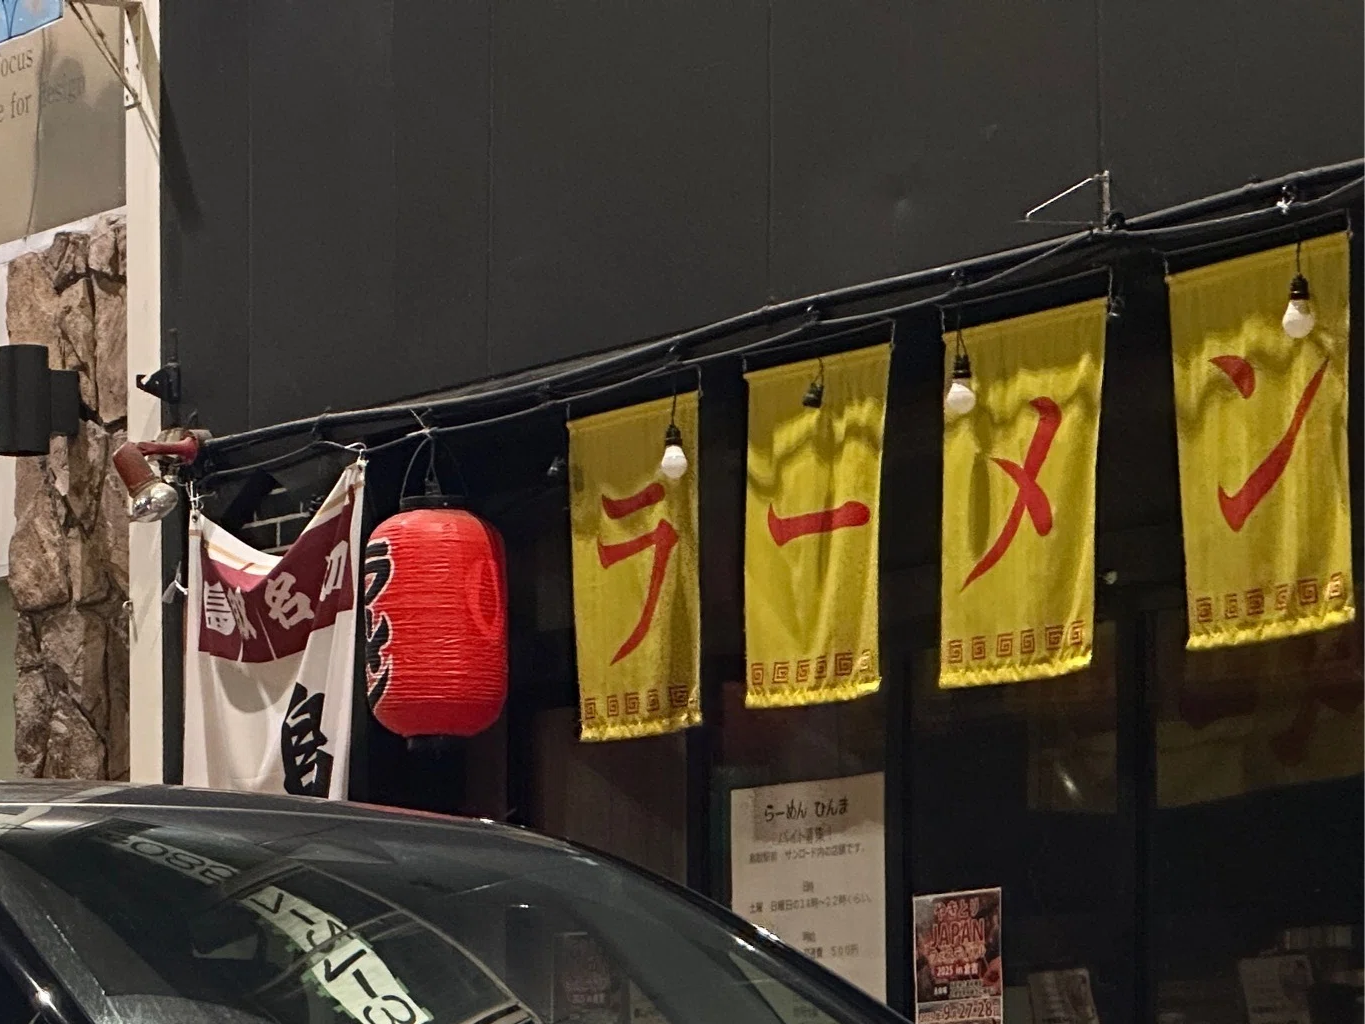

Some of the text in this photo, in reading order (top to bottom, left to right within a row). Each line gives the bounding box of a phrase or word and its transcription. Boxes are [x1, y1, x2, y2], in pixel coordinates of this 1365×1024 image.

[10, 91, 34, 119] for
[764, 798, 808, 823] らーめん
[931, 918, 986, 947] JAPAN
